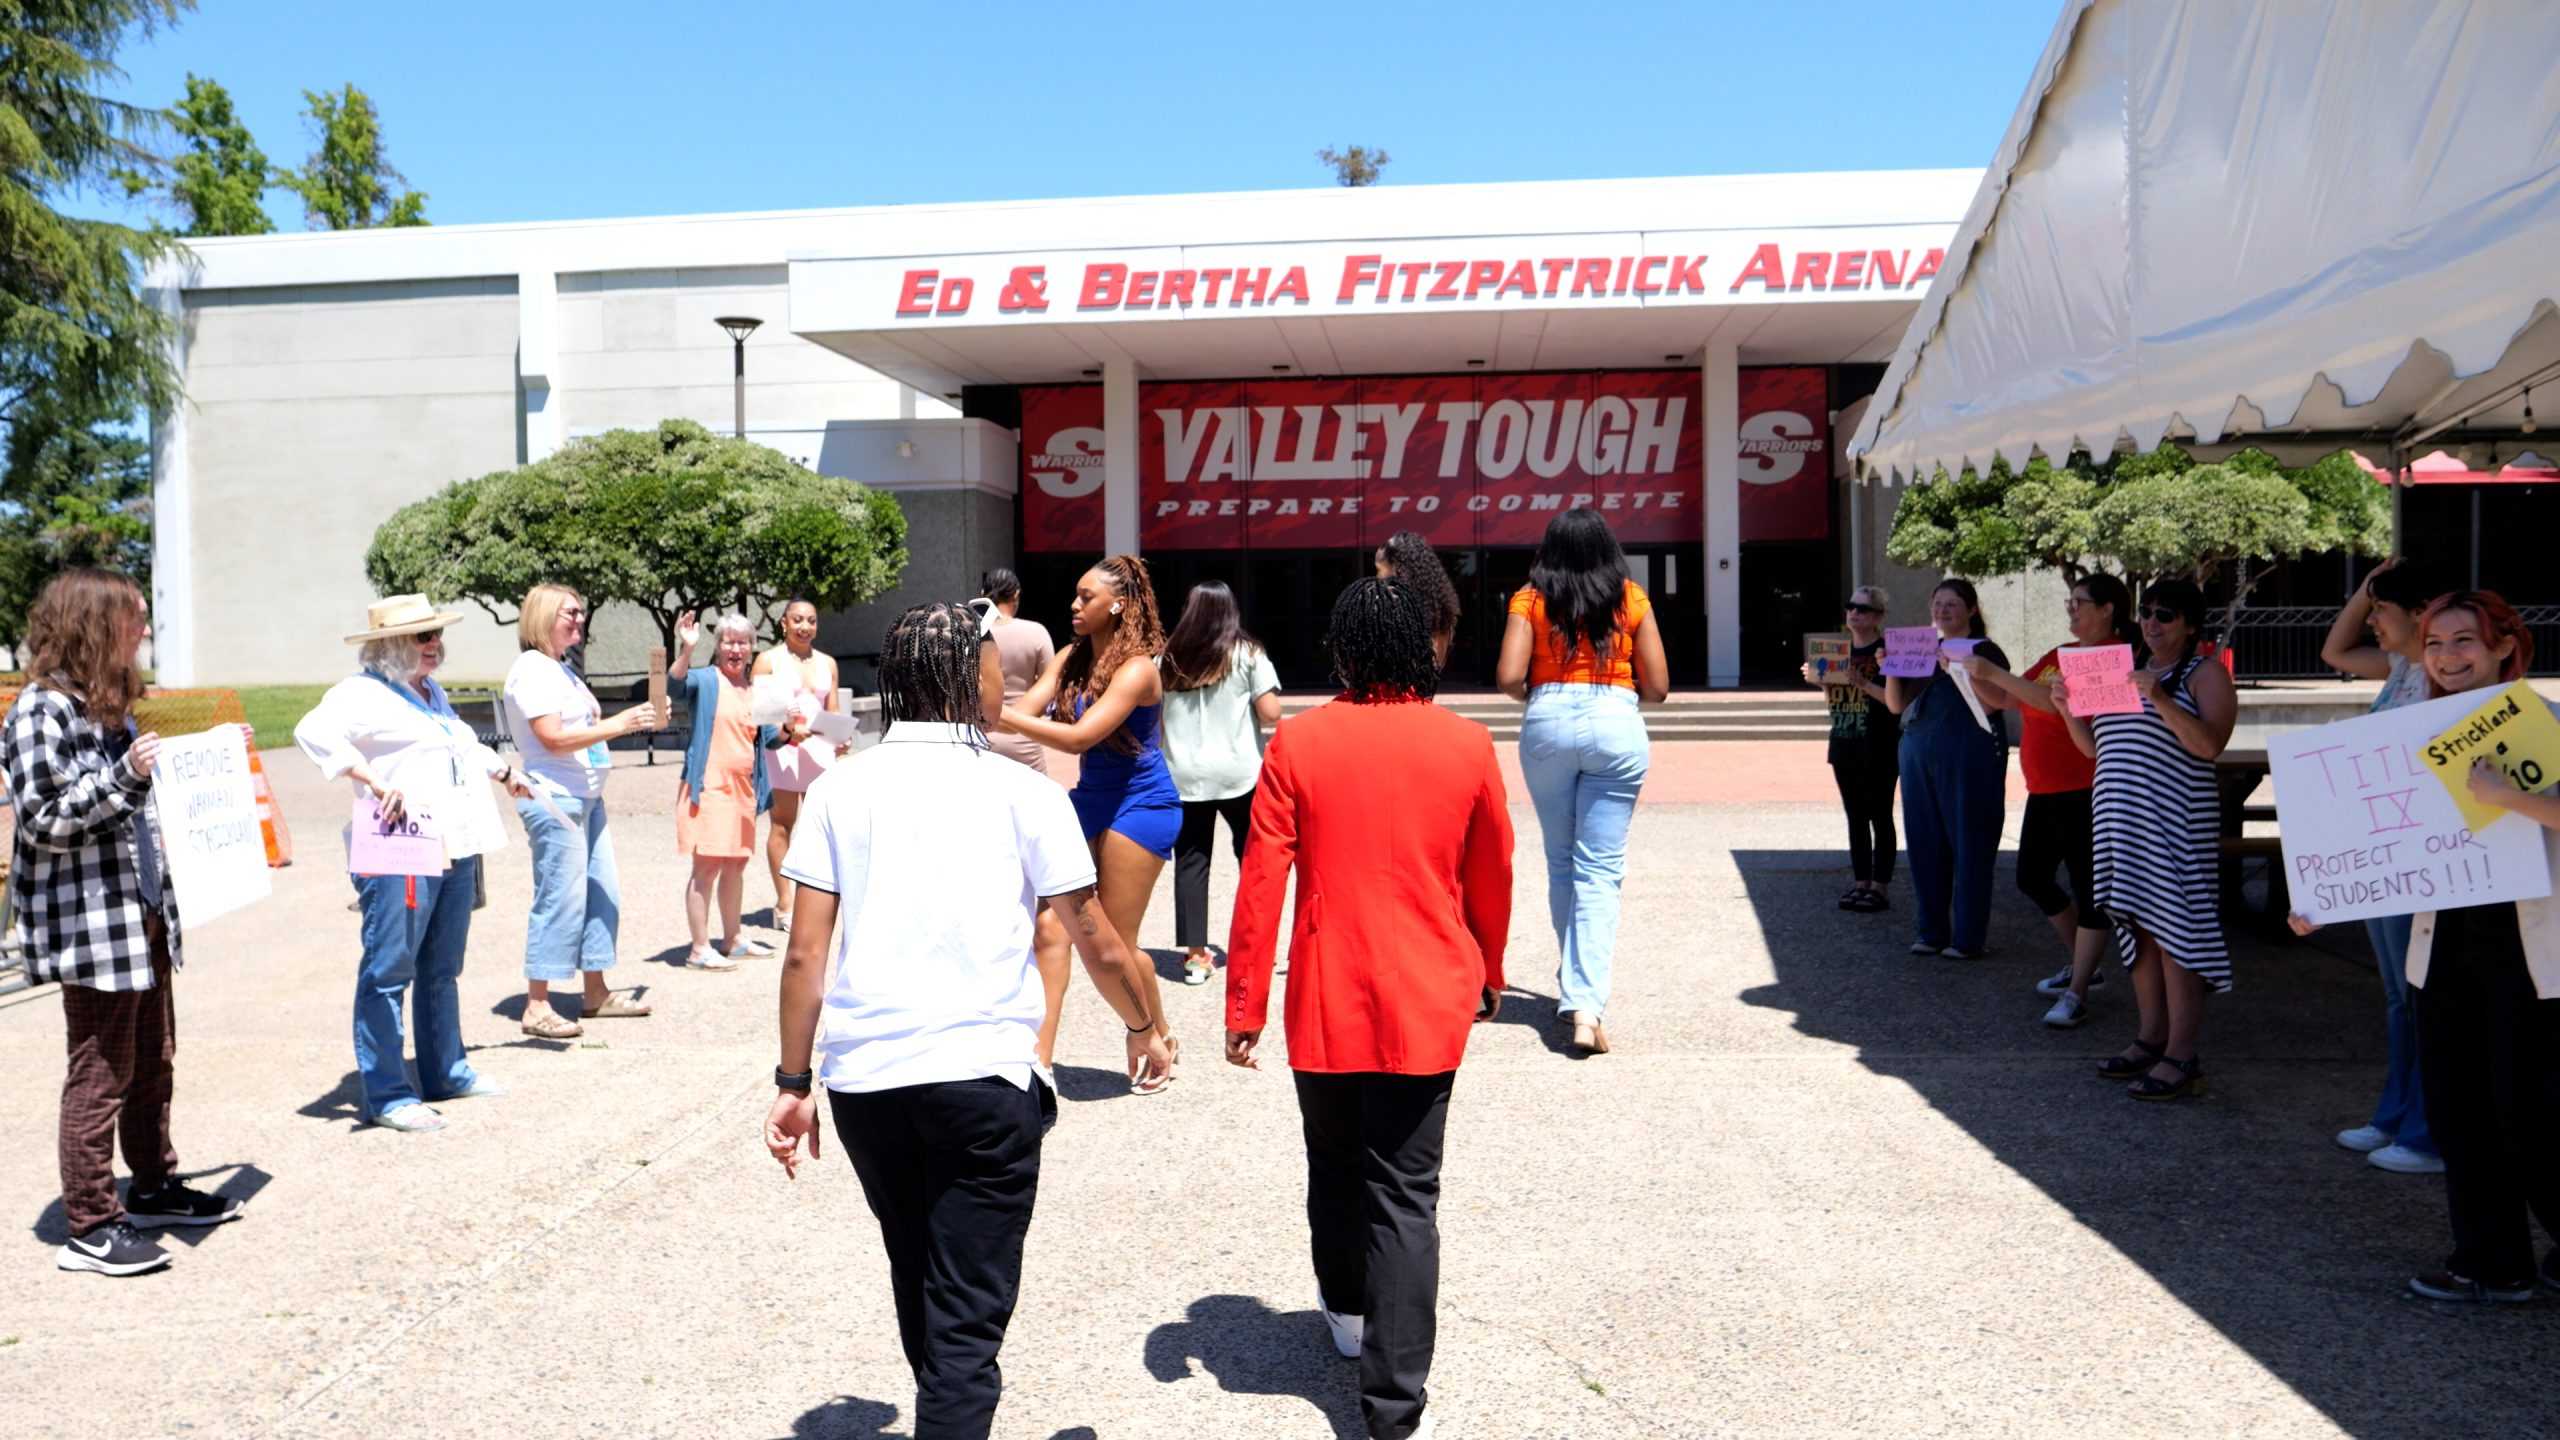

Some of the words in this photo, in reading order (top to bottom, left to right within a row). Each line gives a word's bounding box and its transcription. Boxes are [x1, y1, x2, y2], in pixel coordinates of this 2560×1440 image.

[897, 269, 974, 316] ED
[998, 265, 1049, 311] &
[1077, 263, 1309, 310] BERTHA
[1336, 254, 1709, 302] FITZPATRICK
[1730, 243, 1945, 292] ARENA
[1030, 454, 1105, 469] WARRIO
[1154, 403, 1424, 483] VALLEY
[1437, 396, 1687, 478] TOUGH
[1156, 497, 1363, 517] PREPARE
[1390, 496, 1440, 513] TO
[1467, 491, 1684, 512] COMPETE
[2428, 695, 2522, 766] Strickland
[2294, 735, 2440, 797] TITL
[2361, 787, 2424, 835] IX
[2296, 840, 2401, 885] PROTECT
[2425, 828, 2488, 855] OUR
